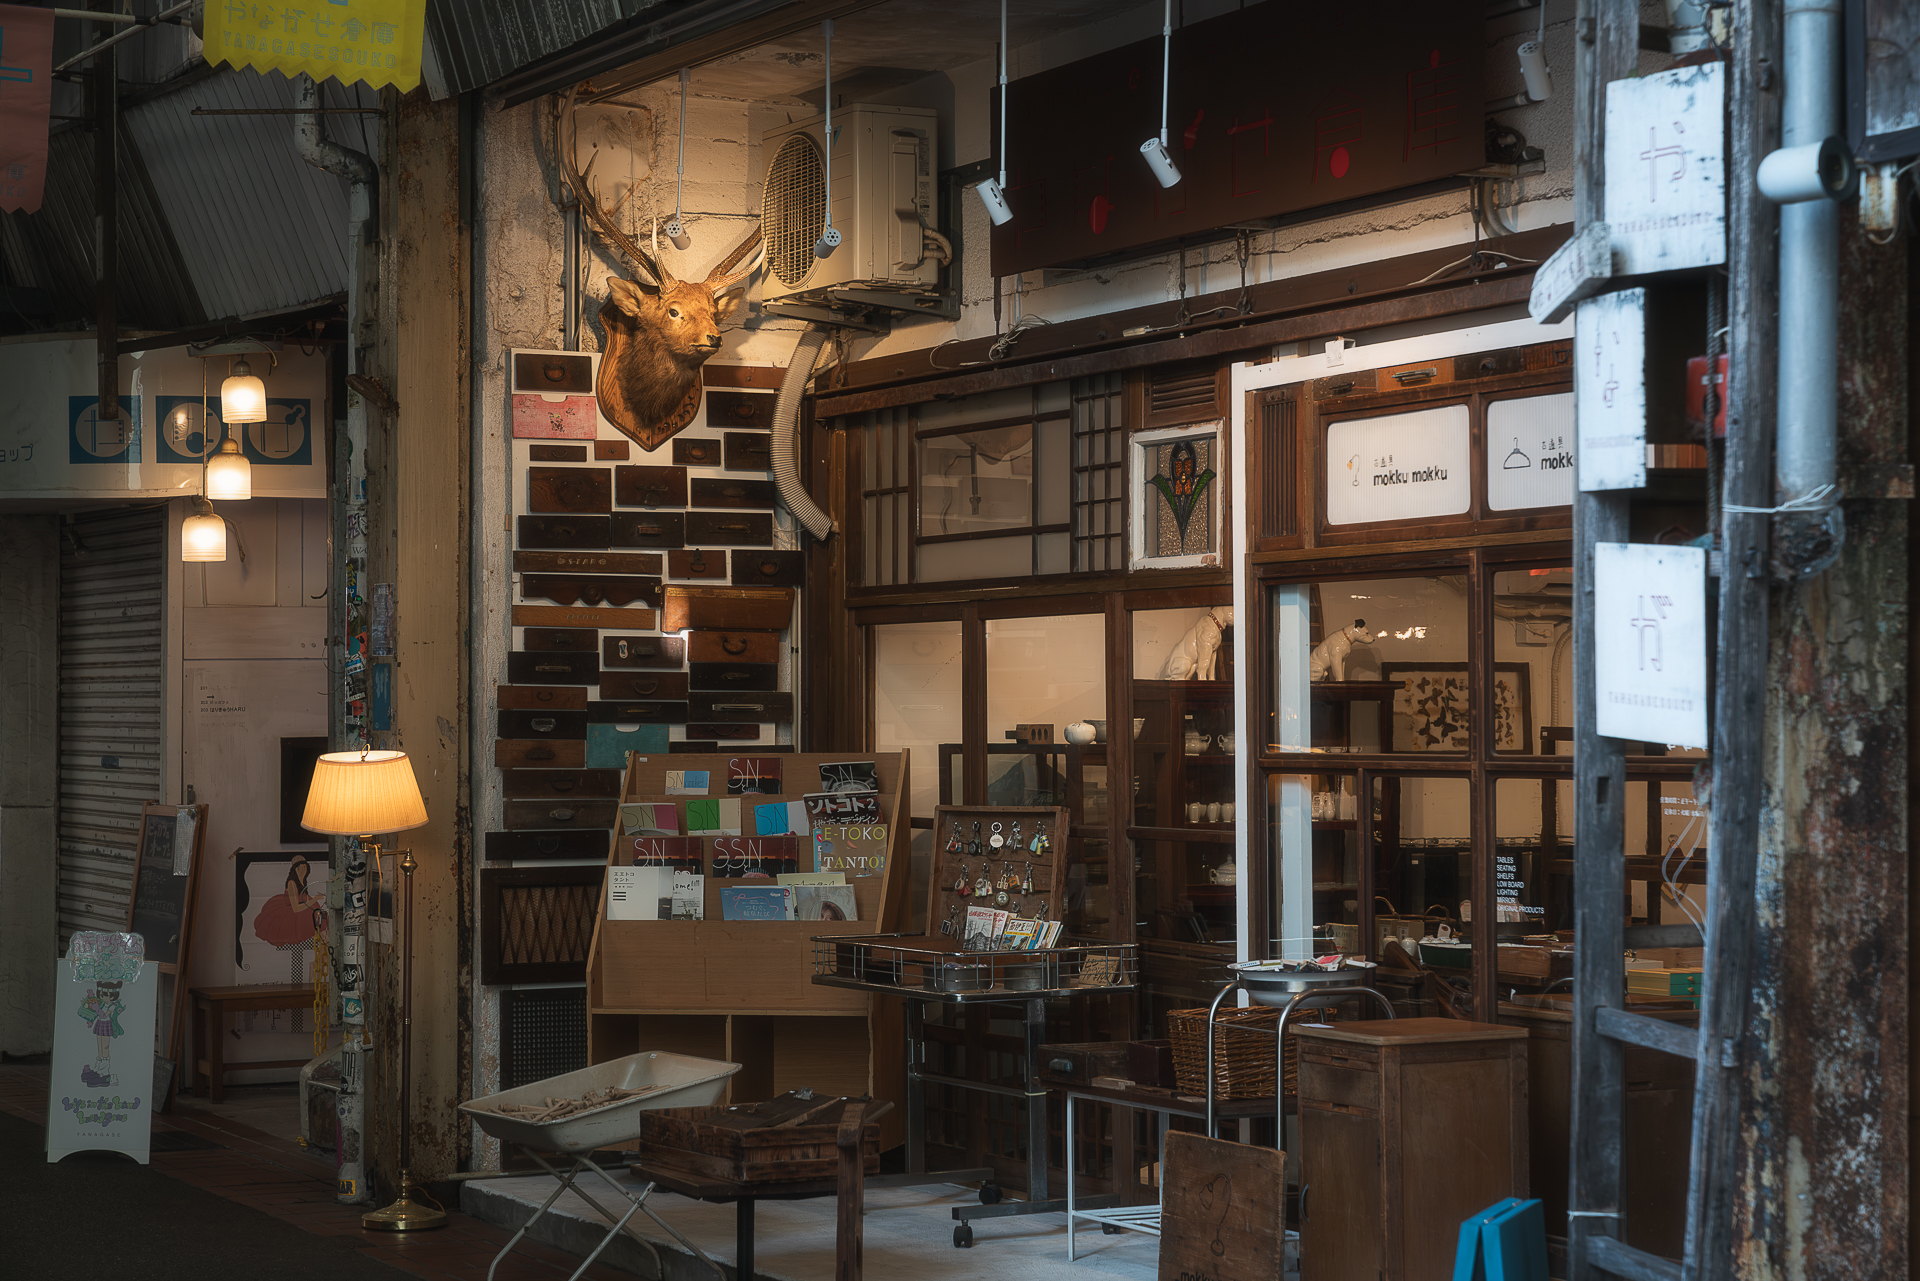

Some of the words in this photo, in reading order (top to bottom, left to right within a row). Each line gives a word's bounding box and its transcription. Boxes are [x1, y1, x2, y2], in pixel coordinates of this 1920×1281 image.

[224, 0, 399, 45] やながせ倉庫
[223, 30, 396, 69] YANAGASESOUKO
[1541, 452, 1574, 470] mokk
[1373, 469, 1409, 486] mokku
[1412, 464, 1447, 483] mokku
[808, 797, 865, 814] ソトコト
[824, 827, 886, 840] E-TOKO
[824, 856, 884, 869] TANTO!
[1496, 856, 1514, 864] TABLES
[1496, 864, 1516, 872] SEATING
[1496, 872, 1515, 880] SHELFS
[1508, 881, 1525, 889] BOARD
[1496, 896, 1515, 904] MIRROR
[1496, 905, 1518, 913] ORIGINAL
[1519, 905, 1545, 914] PRODUCTS
